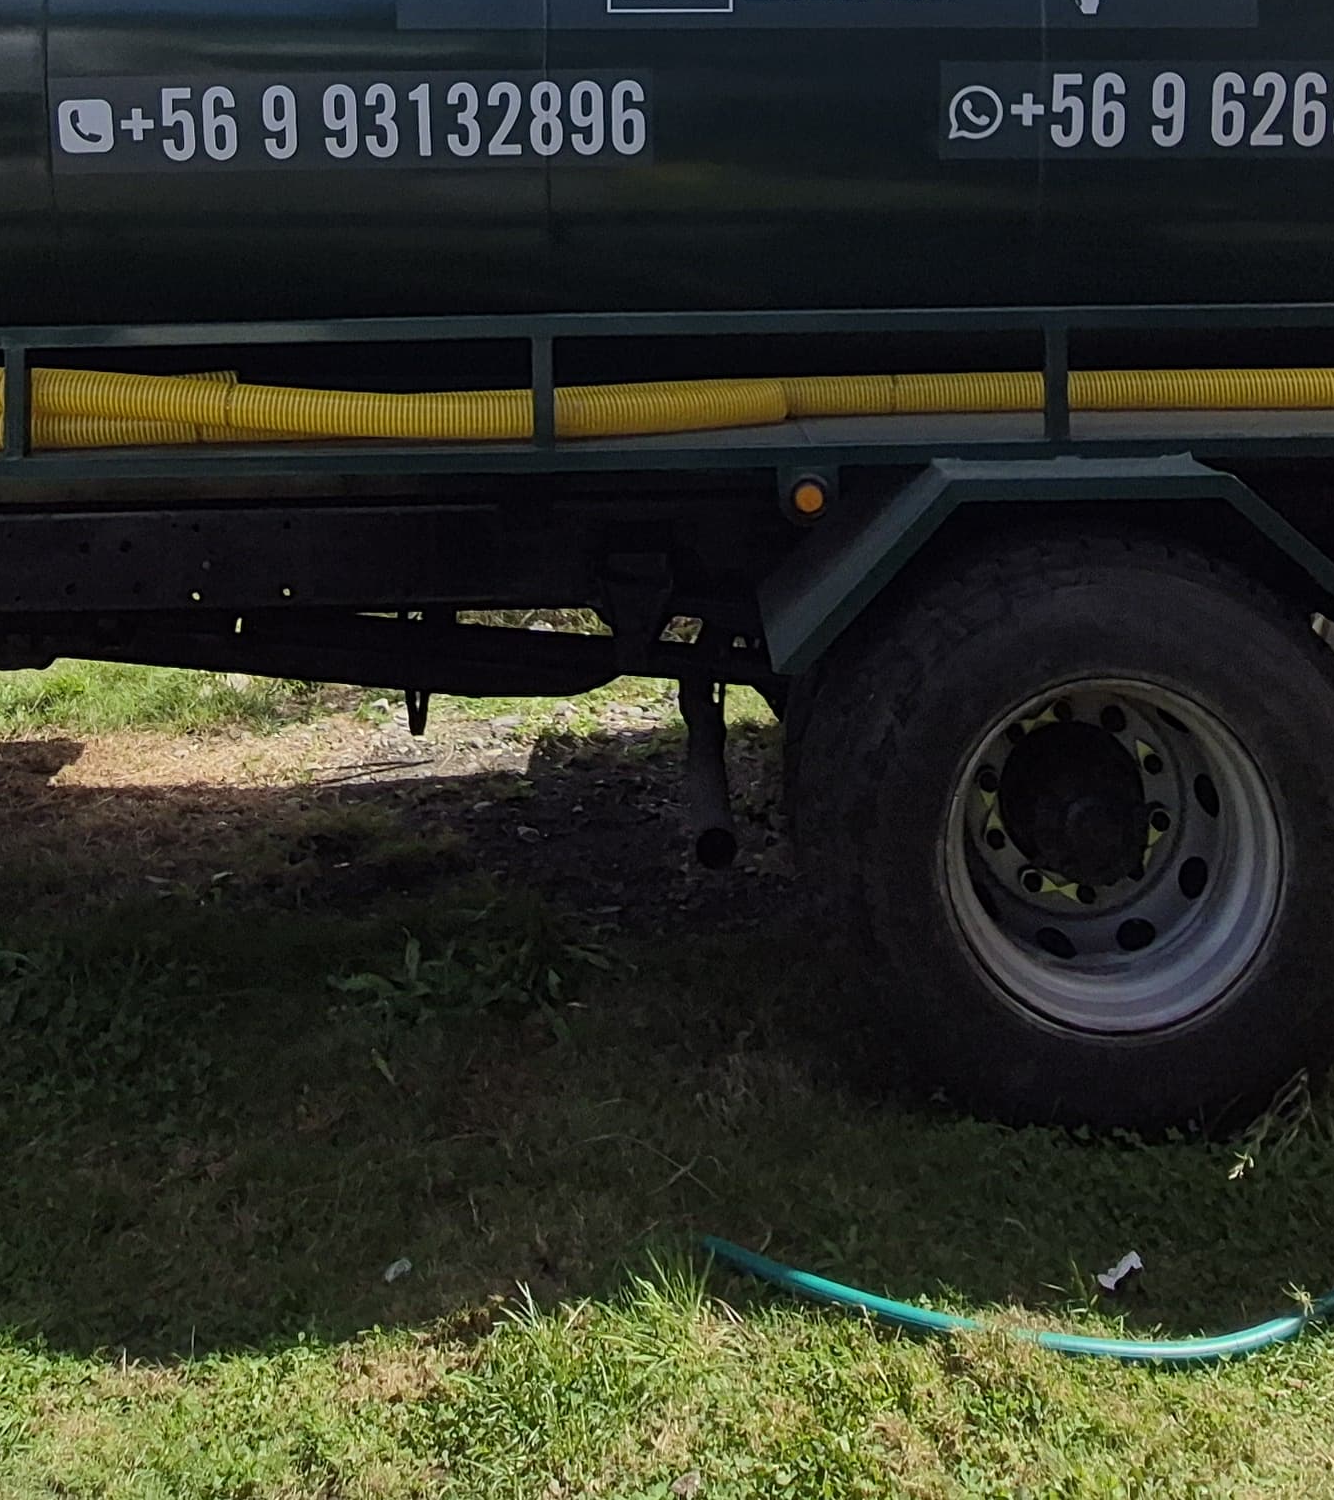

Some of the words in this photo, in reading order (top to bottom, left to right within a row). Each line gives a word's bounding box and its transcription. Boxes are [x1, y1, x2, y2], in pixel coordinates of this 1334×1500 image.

[120, 85, 238, 162] +56
[262, 84, 298, 160] 9
[322, 79, 647, 159] 93132896
[1010, 71, 1126, 148] +56
[1151, 71, 1187, 147] 9
